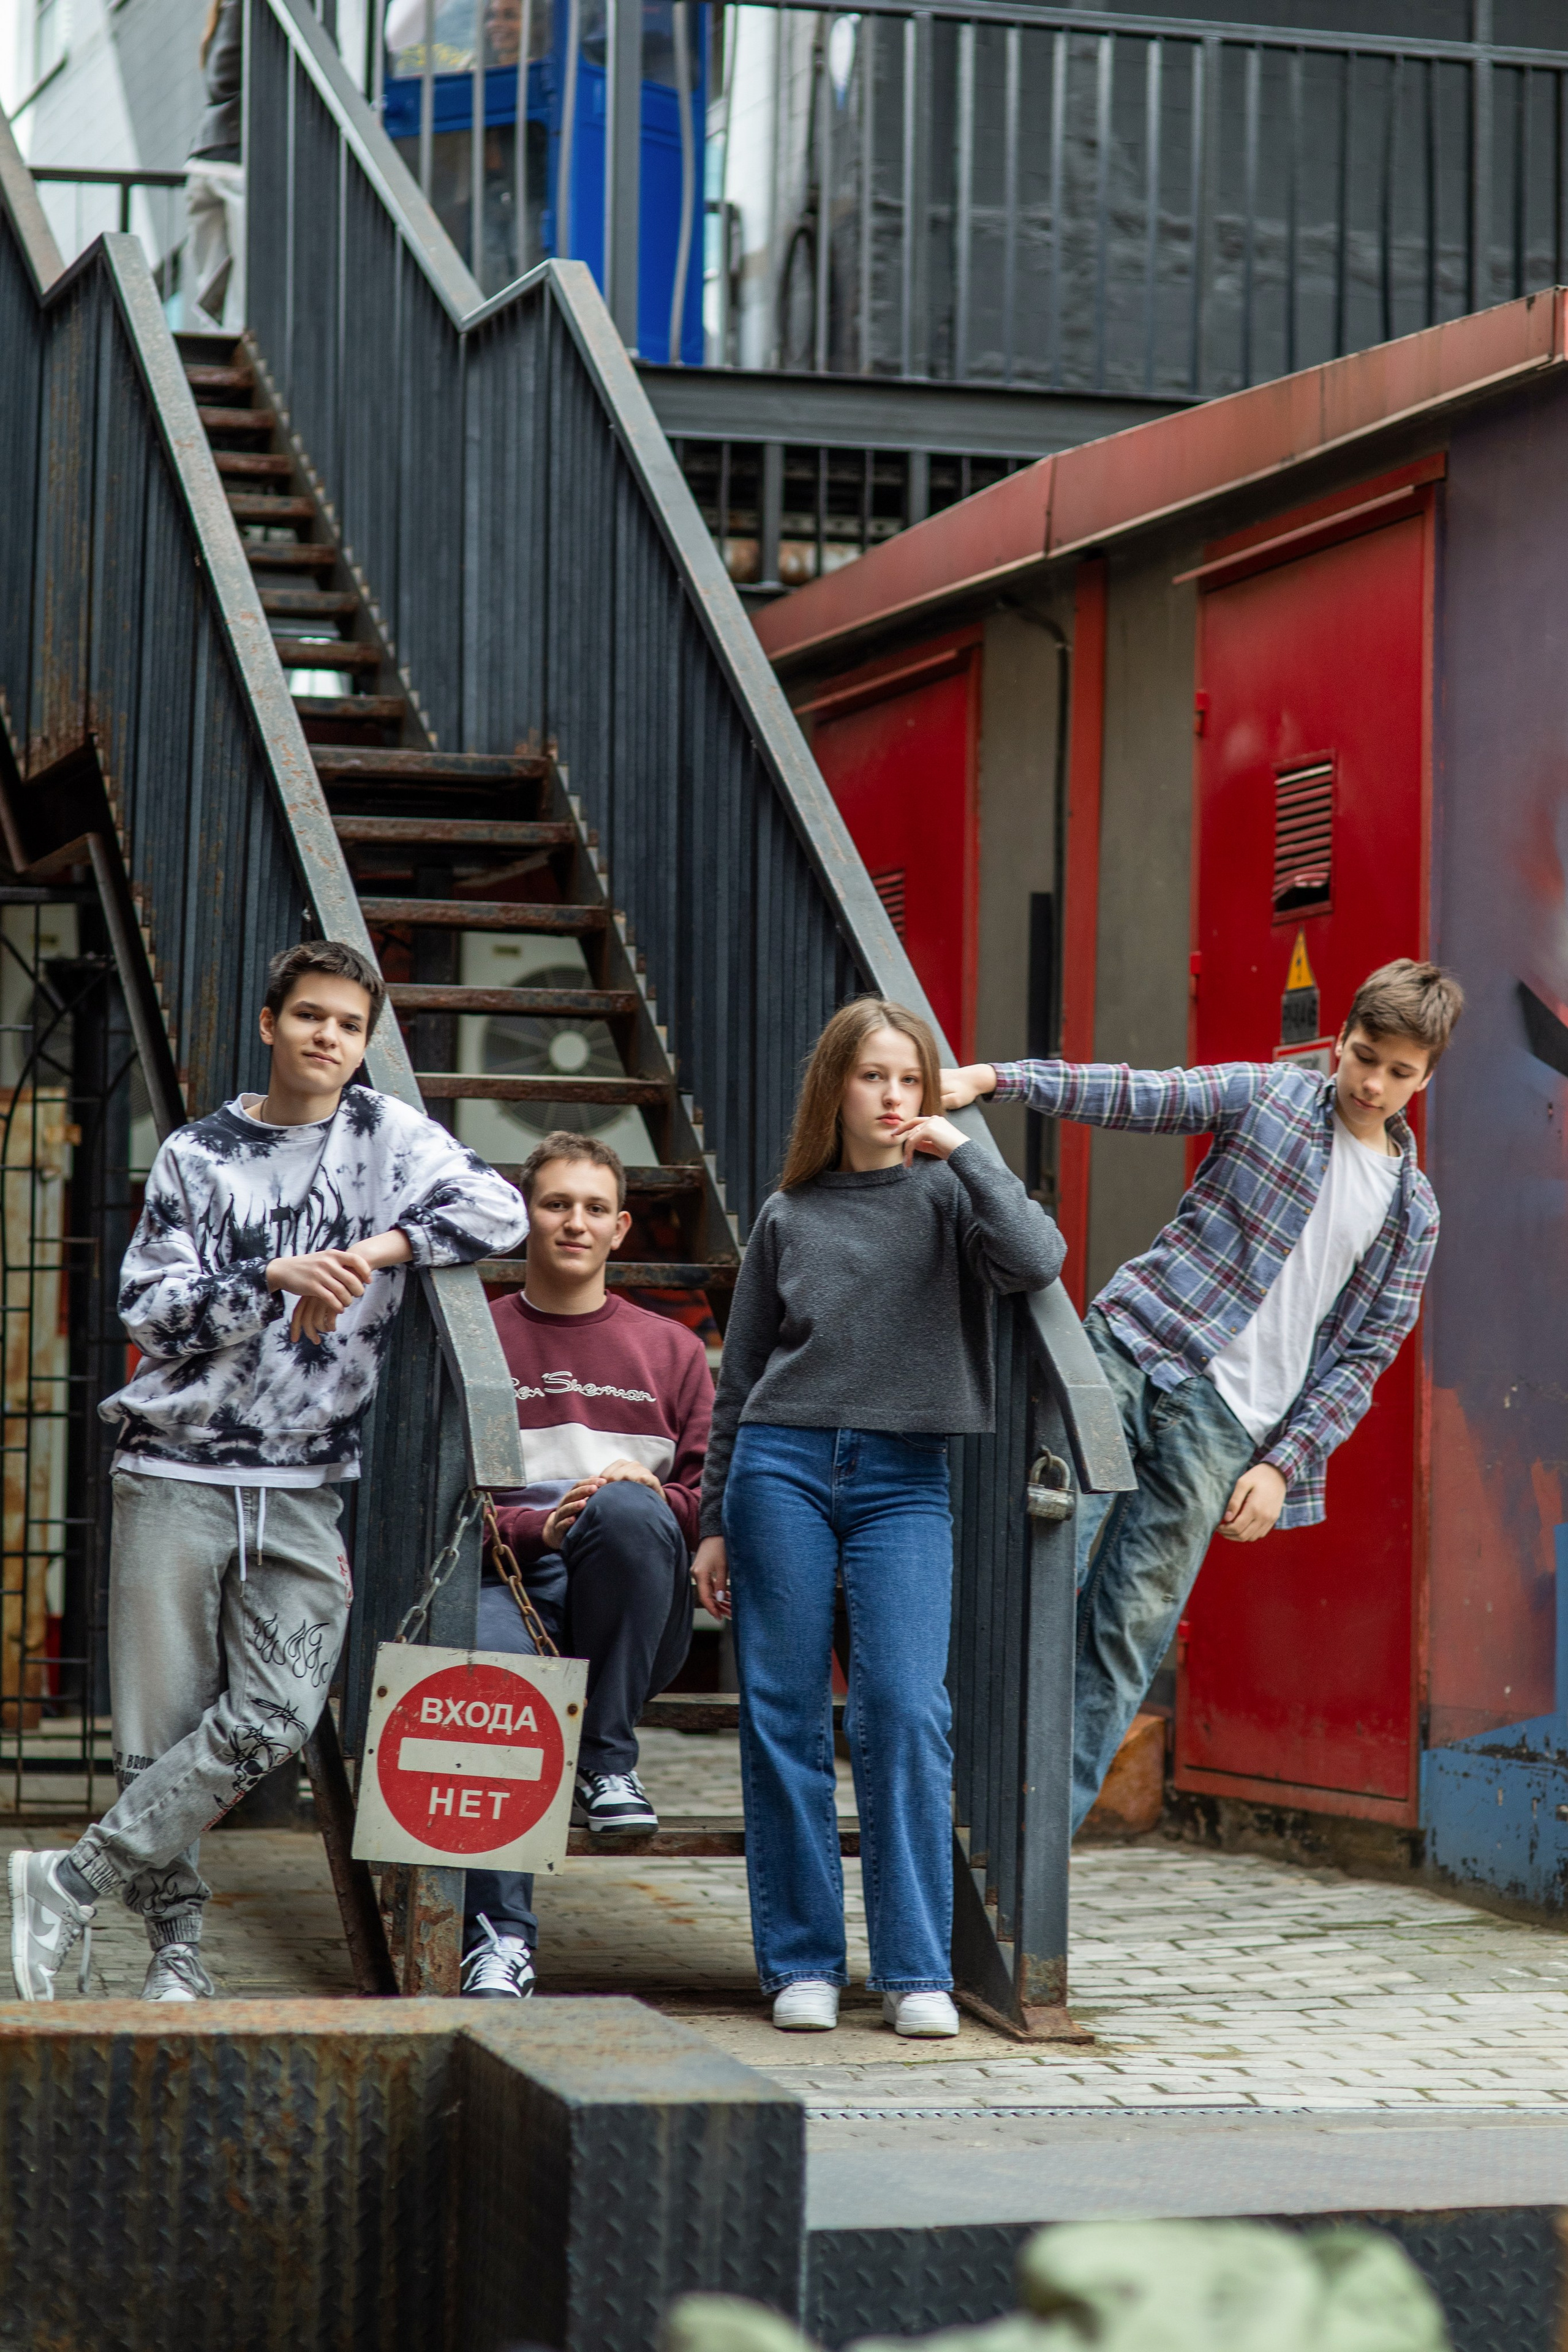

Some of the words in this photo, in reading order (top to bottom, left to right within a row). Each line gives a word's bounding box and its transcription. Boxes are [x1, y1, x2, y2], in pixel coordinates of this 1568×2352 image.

[541, 1371, 657, 1402] Sherman
[420, 1697, 538, 1735] ВХОДА
[428, 1787, 511, 1820] НЕТ
